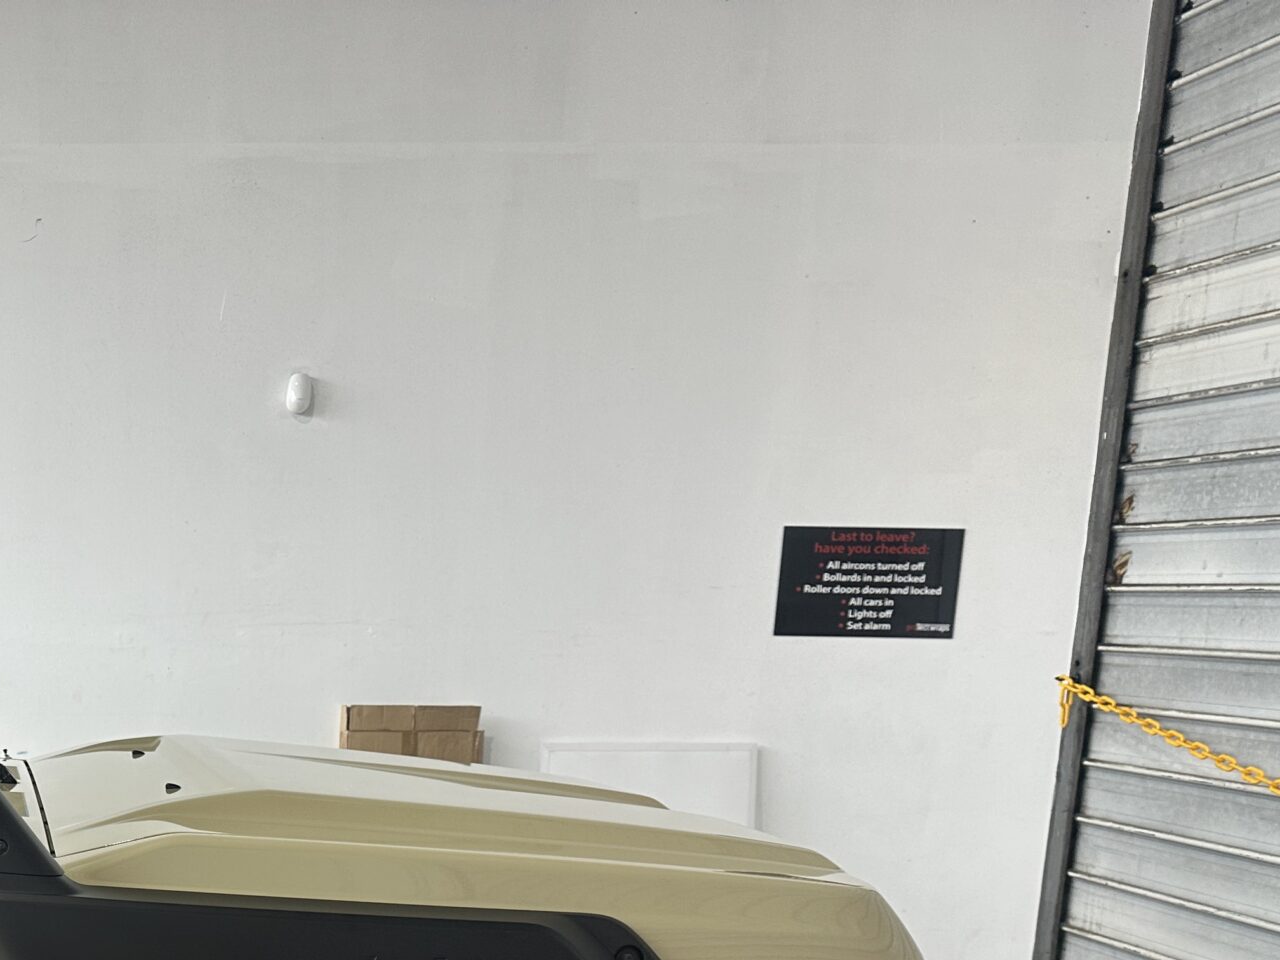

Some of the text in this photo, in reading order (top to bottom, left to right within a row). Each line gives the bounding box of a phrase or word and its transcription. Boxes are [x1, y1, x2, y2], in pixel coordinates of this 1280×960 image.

[831, 531, 916, 542] Last to leave?
[815, 543, 845, 553] have
[848, 546, 871, 556] you
[826, 561, 926, 571] All aircons turned off
[822, 573, 926, 583] Bollards in and locked
[803, 585, 942, 595] Roller doors down and locked
[848, 598, 862, 606] All
[884, 598, 894, 606] in
[848, 609, 893, 620] Lights off
[846, 621, 891, 630] Set alarm
